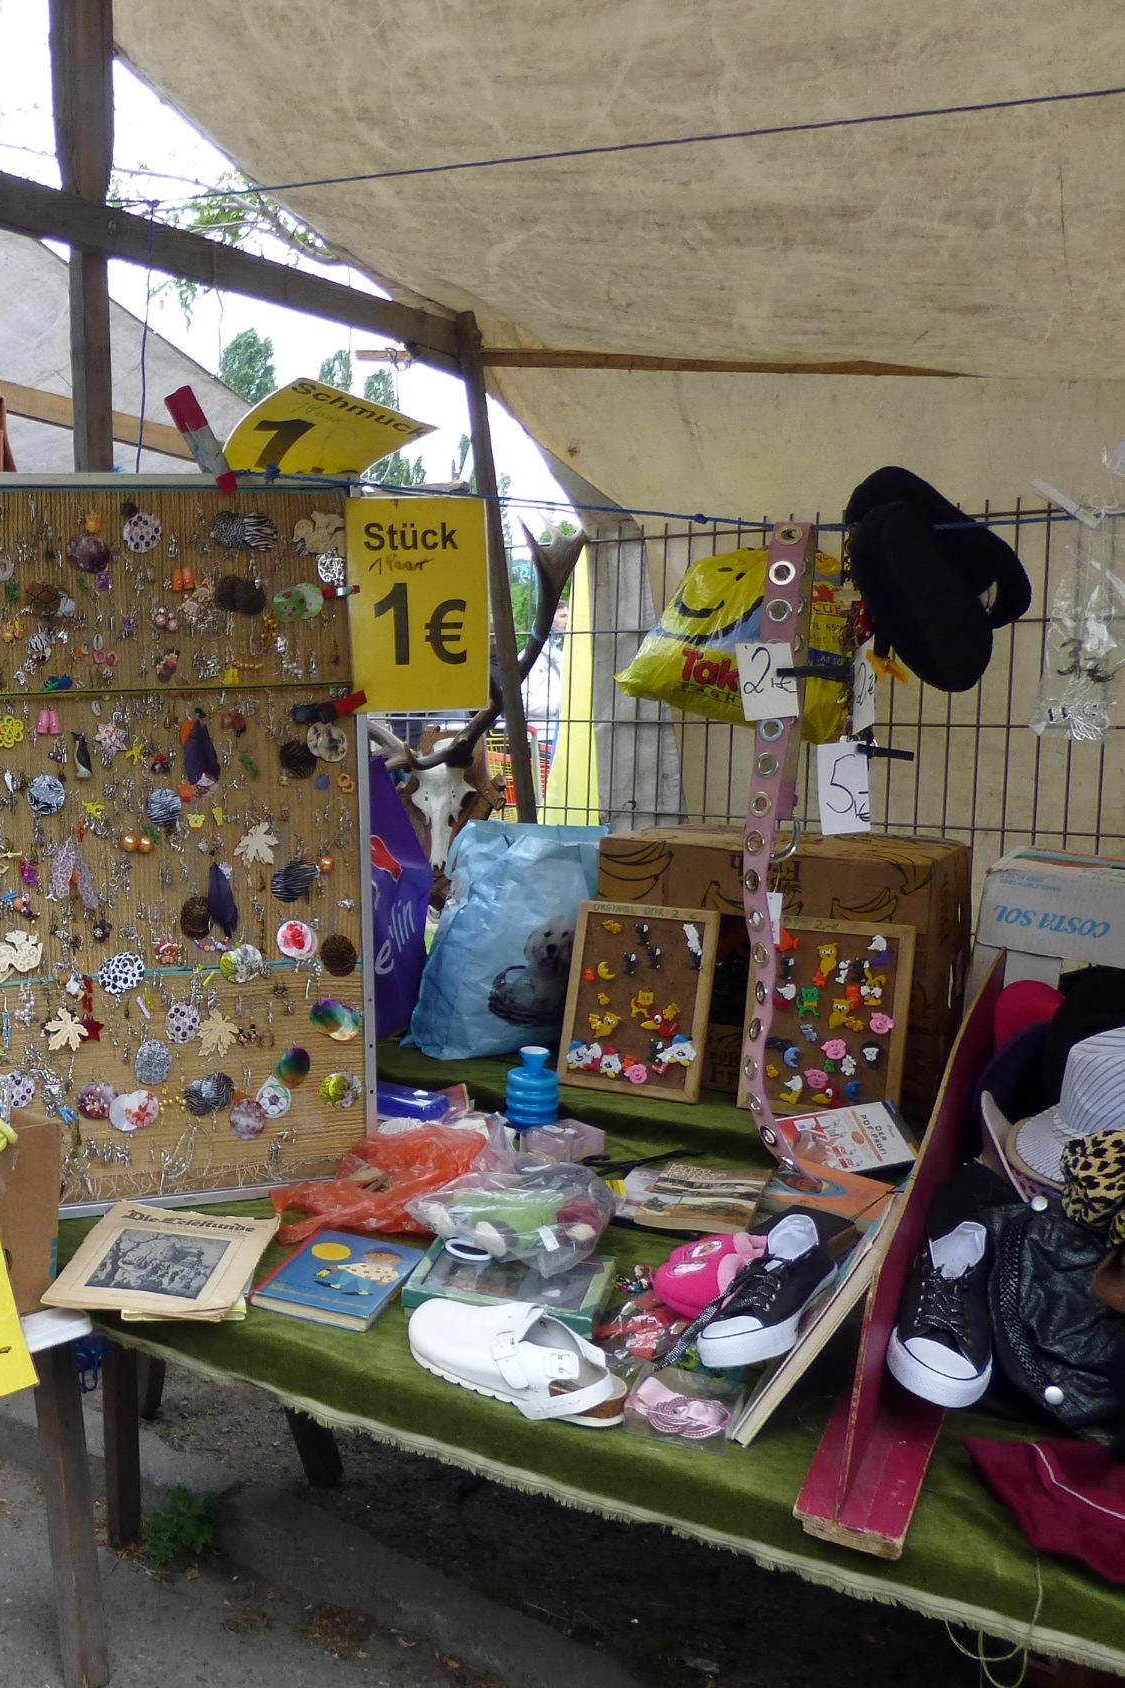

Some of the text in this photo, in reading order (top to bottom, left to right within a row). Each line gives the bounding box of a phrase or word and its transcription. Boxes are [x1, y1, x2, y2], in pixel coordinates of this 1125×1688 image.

[292, 382, 427, 437] Schmuck
[363, 522, 459, 551] Stück
[682, 648, 739, 693] Tak
[994, 904, 1111, 938] COSTA SOL
[121, 1209, 159, 1223] Die
